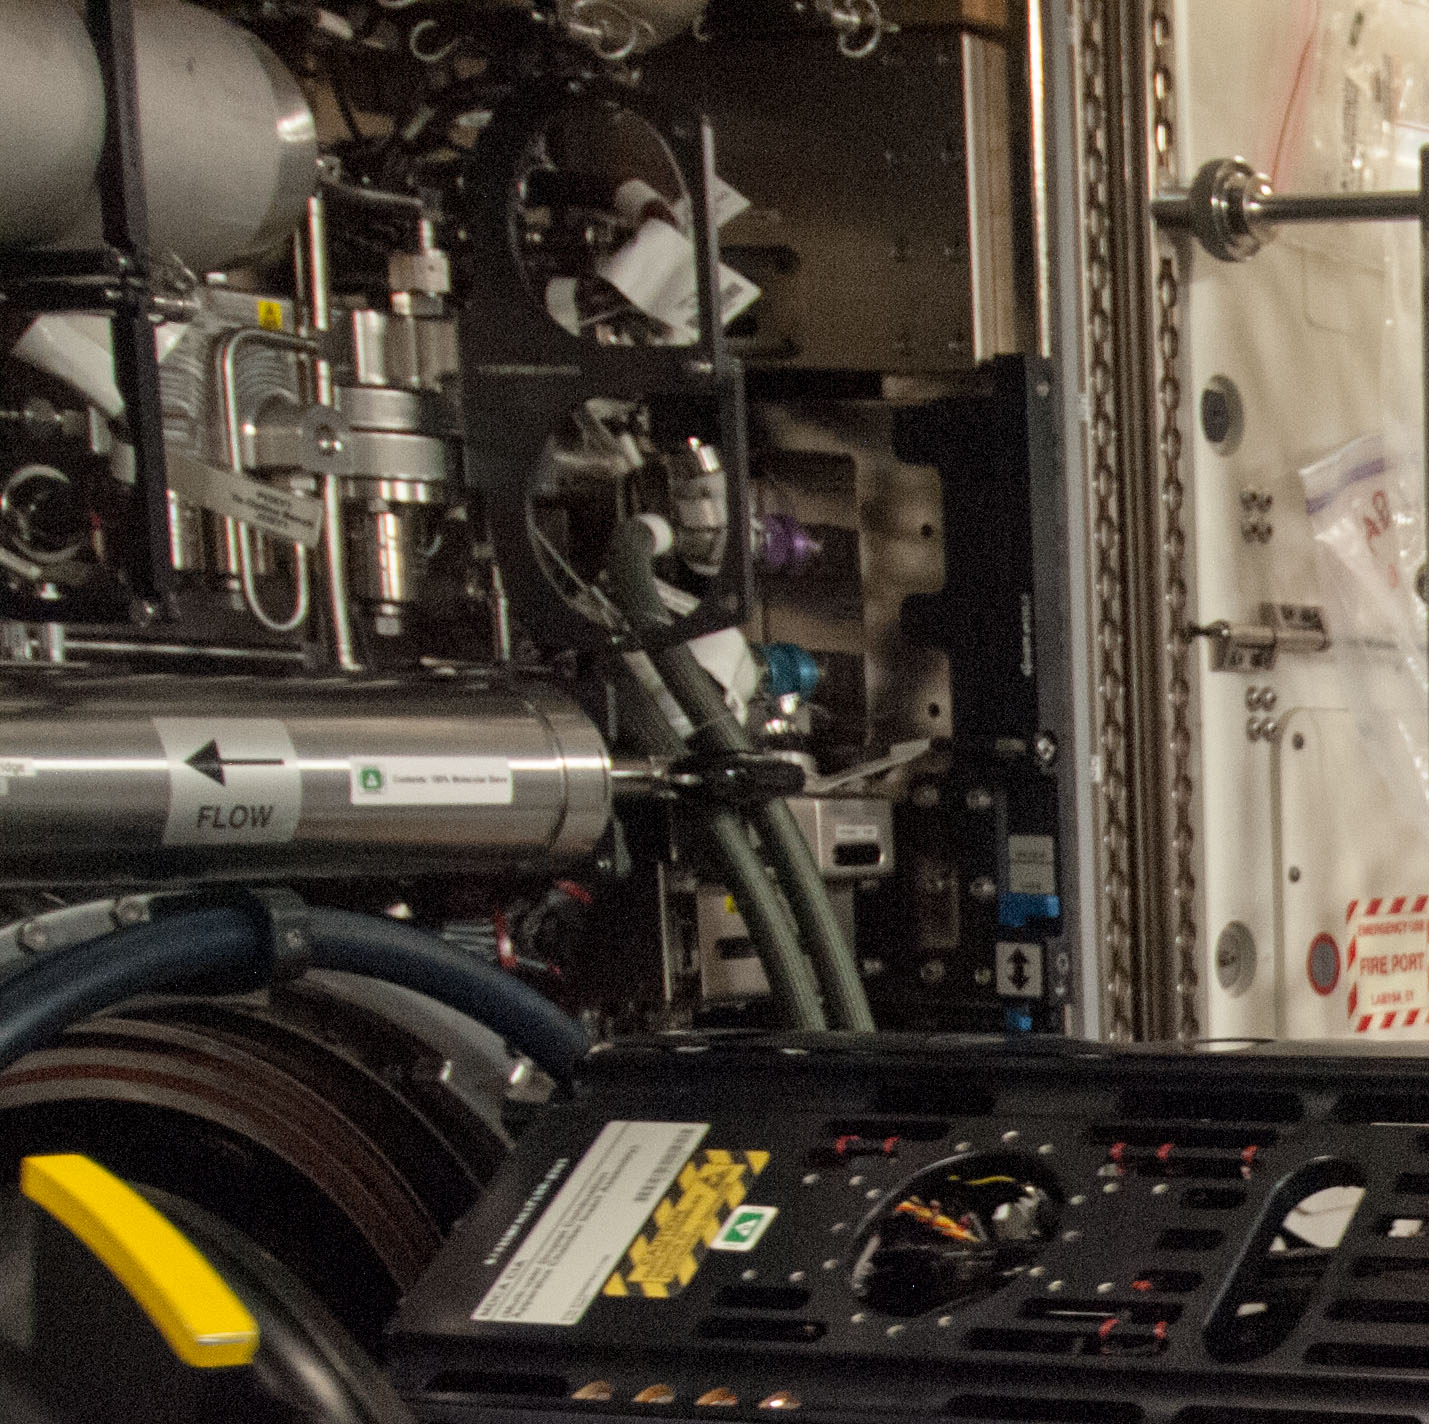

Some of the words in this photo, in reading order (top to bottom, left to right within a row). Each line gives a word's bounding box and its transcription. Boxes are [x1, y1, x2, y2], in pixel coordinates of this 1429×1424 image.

[197, 804, 274, 830] FLOW
[1359, 954, 1388, 977] FIRE
[1392, 951, 1425, 973] PORT
